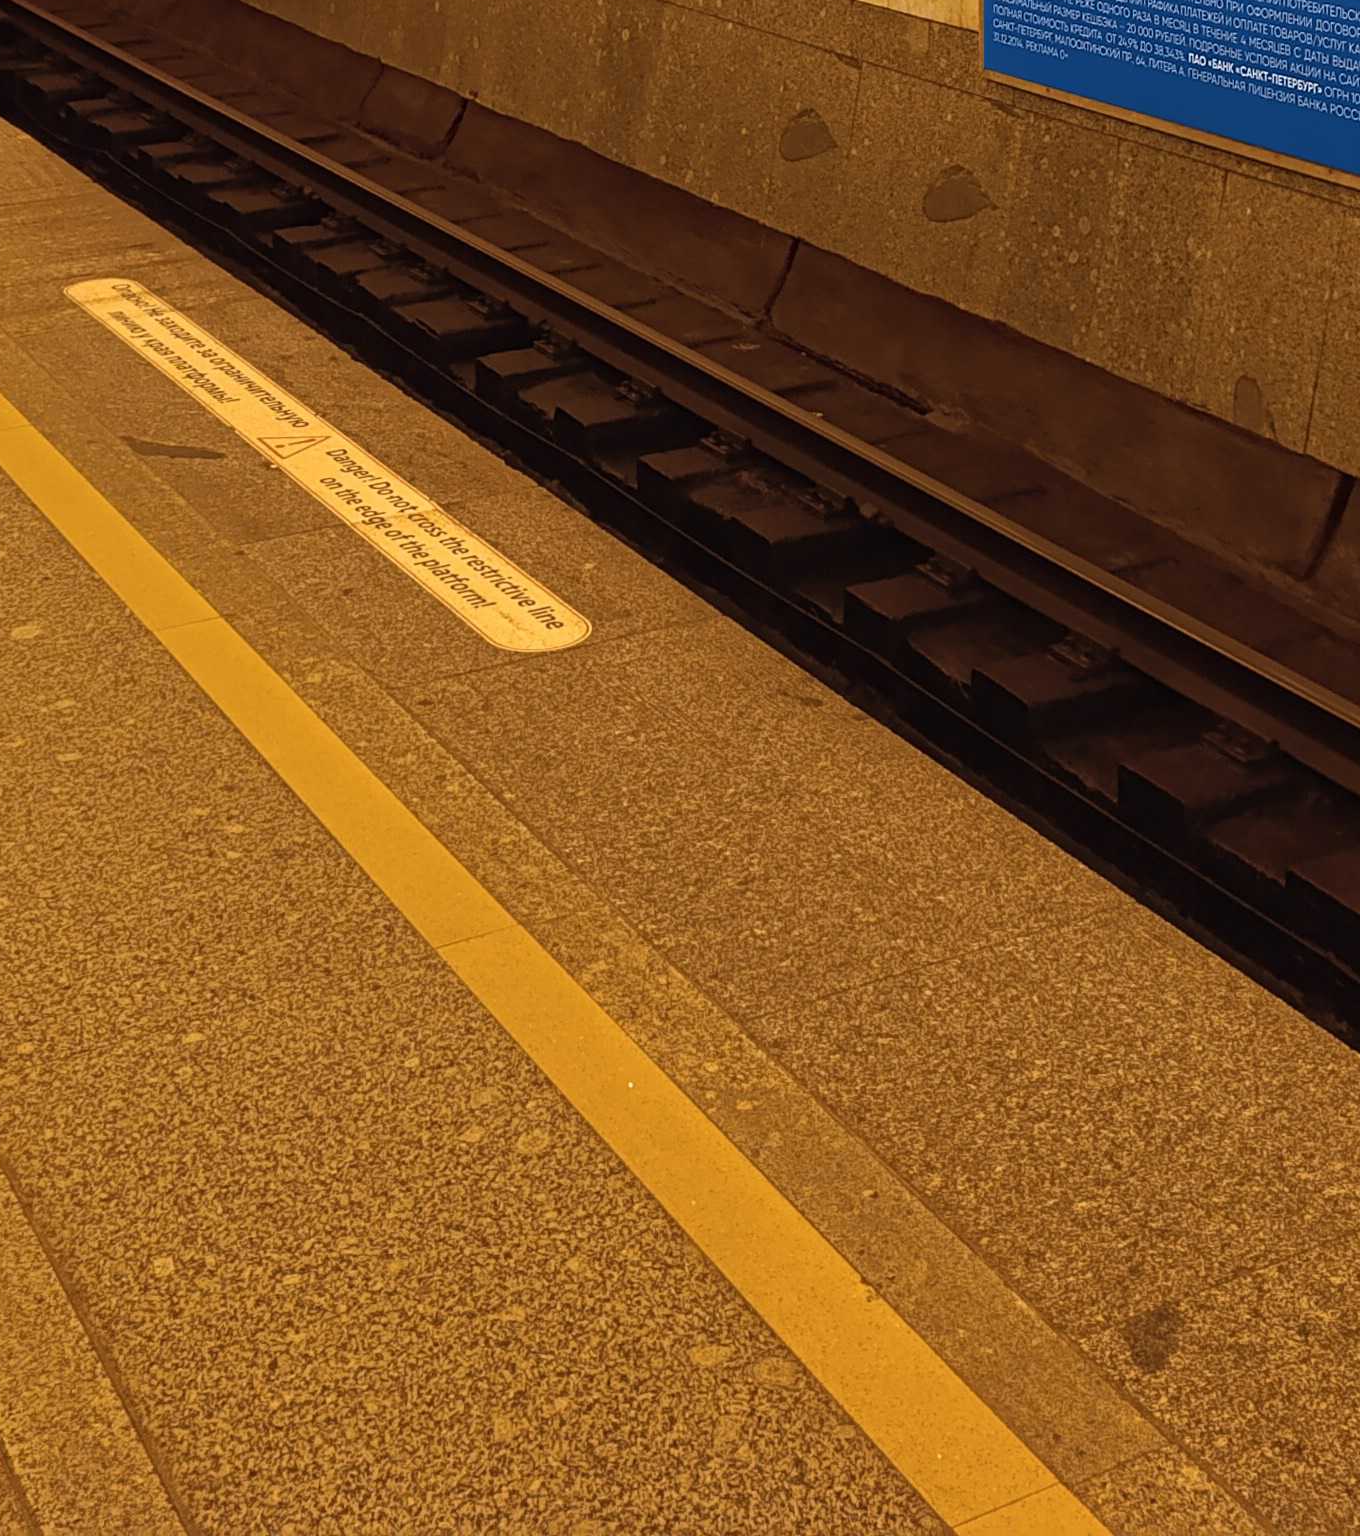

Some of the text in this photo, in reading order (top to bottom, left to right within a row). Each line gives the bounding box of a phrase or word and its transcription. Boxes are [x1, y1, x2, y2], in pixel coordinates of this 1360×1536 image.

[1225, 13, 1232, 26] И
[1232, 15, 1268, 34] ОПЛАТЕ
[1246, 2, 1312, 28] ОФОРМЛЕНИИ
[1193, 22, 1199, 34] В
[1201, 24, 1237, 43] ТЕЧЕНИЕ
[1240, 32, 1246, 45] 4
[1248, 34, 1291, 56] МЕСЯЦЕВ
[1293, 45, 1301, 58] С
[1303, 47, 1329, 65] ДАТЫ
[1207, 56, 1233, 73] «БАНК
[1235, 62, 1322, 95] «САНКТ-ПЕТЕРБУРГ»
[1323, 84, 1349, 102] ОГРН
[1245, 49, 1287, 71] УСЛОВИЯ
[1289, 60, 1321, 79] АКЦИИ
[1323, 68, 1336, 82] НА
[1247, 81, 1295, 105] ЛИЦЕНЗИЯ
[1297, 94, 1327, 113] БАНКА
[320, 477, 497, 609] on the edge of the platform!
[326, 448, 564, 630] Danger! Do not cross the restrictive line
